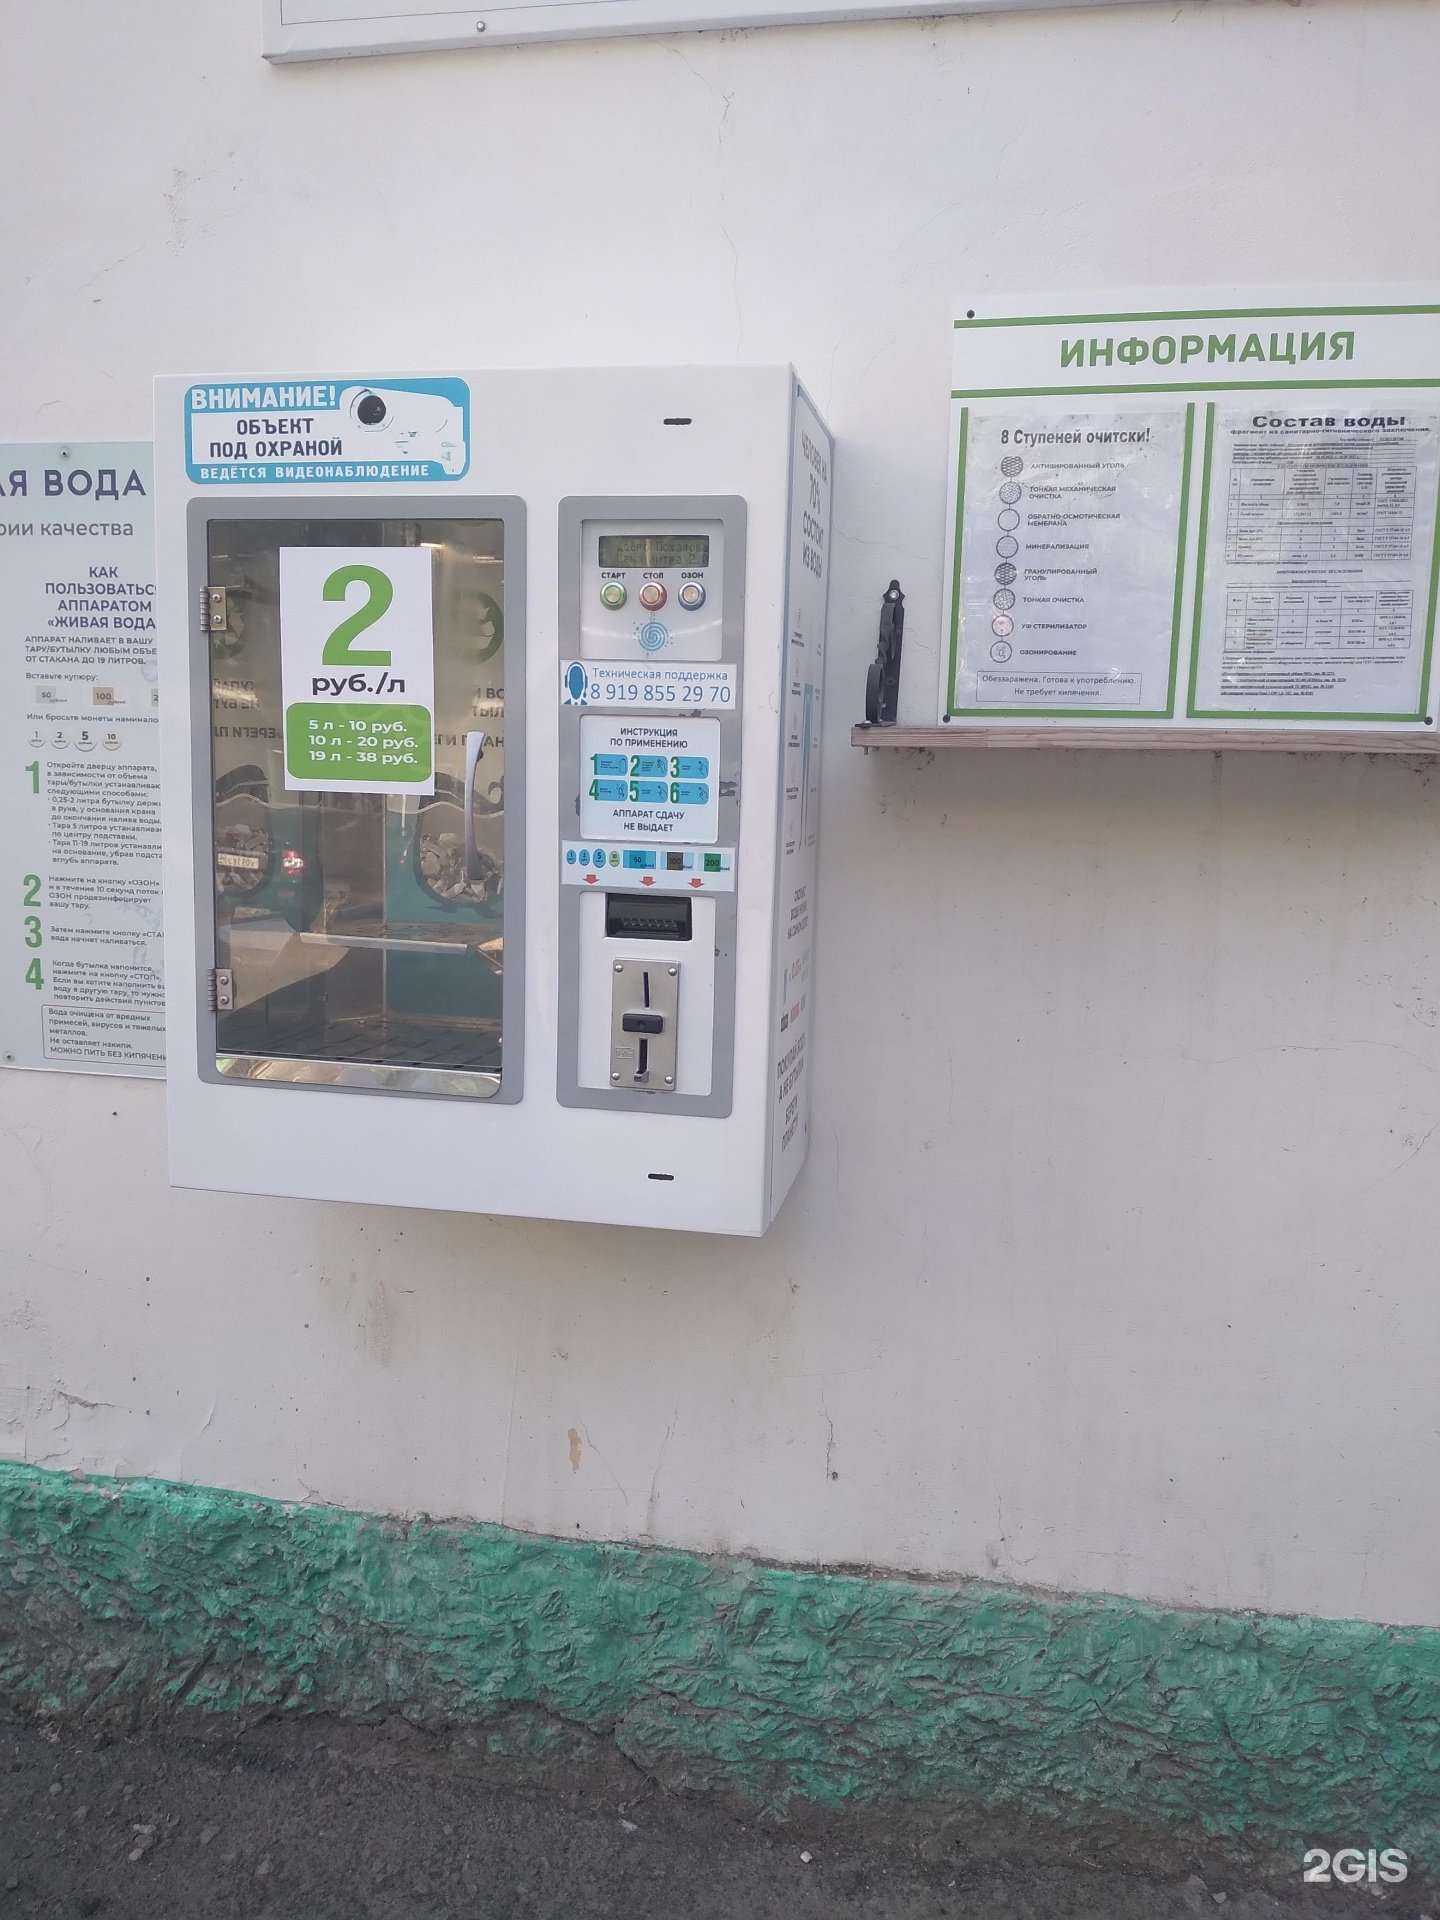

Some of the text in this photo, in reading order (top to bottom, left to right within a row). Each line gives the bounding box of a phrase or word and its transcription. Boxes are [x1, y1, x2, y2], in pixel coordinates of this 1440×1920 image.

[1060, 331, 1355, 367] ИНФОРМАЦИЯ
[191, 385, 336, 410] ВНИМАНИЕ!
[236, 418, 314, 435] ОБЪЕКТ
[1252, 416, 1405, 429] Состав воды
[1001, 428, 1150, 447] 8 Ступеней очитски!
[210, 437, 343, 460] ПОД ОХРАНОЙ
[200, 464, 429, 480] ВЕДЁТСЯ ВИДЕОНАБЛЮДЕНИЕ
[45, 469, 147, 500] ВОДА
[40, 523, 133, 537] качества
[89, 566, 118, 578] КАК
[601, 571, 626, 579] СТАРТ
[643, 571, 664, 579] СТОП
[681, 571, 704, 579] ОЗОН
[45, 583, 156, 595] ПОЛЬЗОВАТЬС
[57, 599, 152, 612] АППАРАТОМ
[48, 616, 109, 628] «ЖИВАЯ
[322, 564, 394, 666] 2
[68, 636, 116, 644] НАЛИВАЕТ
[126, 637, 153, 646] ВАШУ
[94, 646, 130, 655] ЛЮБЫМ
[25, 655, 37, 663] ОТ
[39, 655, 79, 664] СТАКАНА
[82, 656, 95, 665] ДО
[108, 657, 146, 665] ЛИТРОВ.
[592, 667, 728, 682] Техническая поддержка
[312, 671, 405, 696] руб./л
[591, 683, 730, 702] 8 919 855 29 70
[1026, 688, 1056, 697] требует
[308, 720, 318, 730] 5
[323, 721, 333, 730] л
[349, 719, 367, 730] 10
[371, 720, 407, 735] руб.
[620, 727, 678, 737] ИНСТРУКЦИЯ
[82, 731, 89, 741] 5
[308, 735, 326, 746] 10
[330, 736, 342, 745] л
[357, 736, 379, 747] 20
[382, 736, 418, 750] руб.
[610, 737, 688, 749] ПО ПРИМЕНЕНИЮ
[309, 750, 326, 761] 19
[330, 752, 341, 761] л
[356, 751, 378, 762] 38
[382, 751, 418, 766] руб.
[590, 753, 599, 776] 1
[630, 755, 640, 777] 2
[670, 756, 680, 778] 3
[25, 761, 39, 794] 1
[589, 779, 600, 800] 4
[629, 780, 640, 802] 5
[670, 781, 680, 804] 6
[613, 809, 685, 820] АППАРАТ СДАЧУ
[624, 822, 673, 832] НЕ ВЫДАЕТ
[23, 874, 41, 907] 2
[24, 916, 42, 948] 3
[25, 957, 44, 990] 4
[84, 1048, 106, 1056] ПИТЬ
[107, 1050, 122, 1058] БЕЗ
